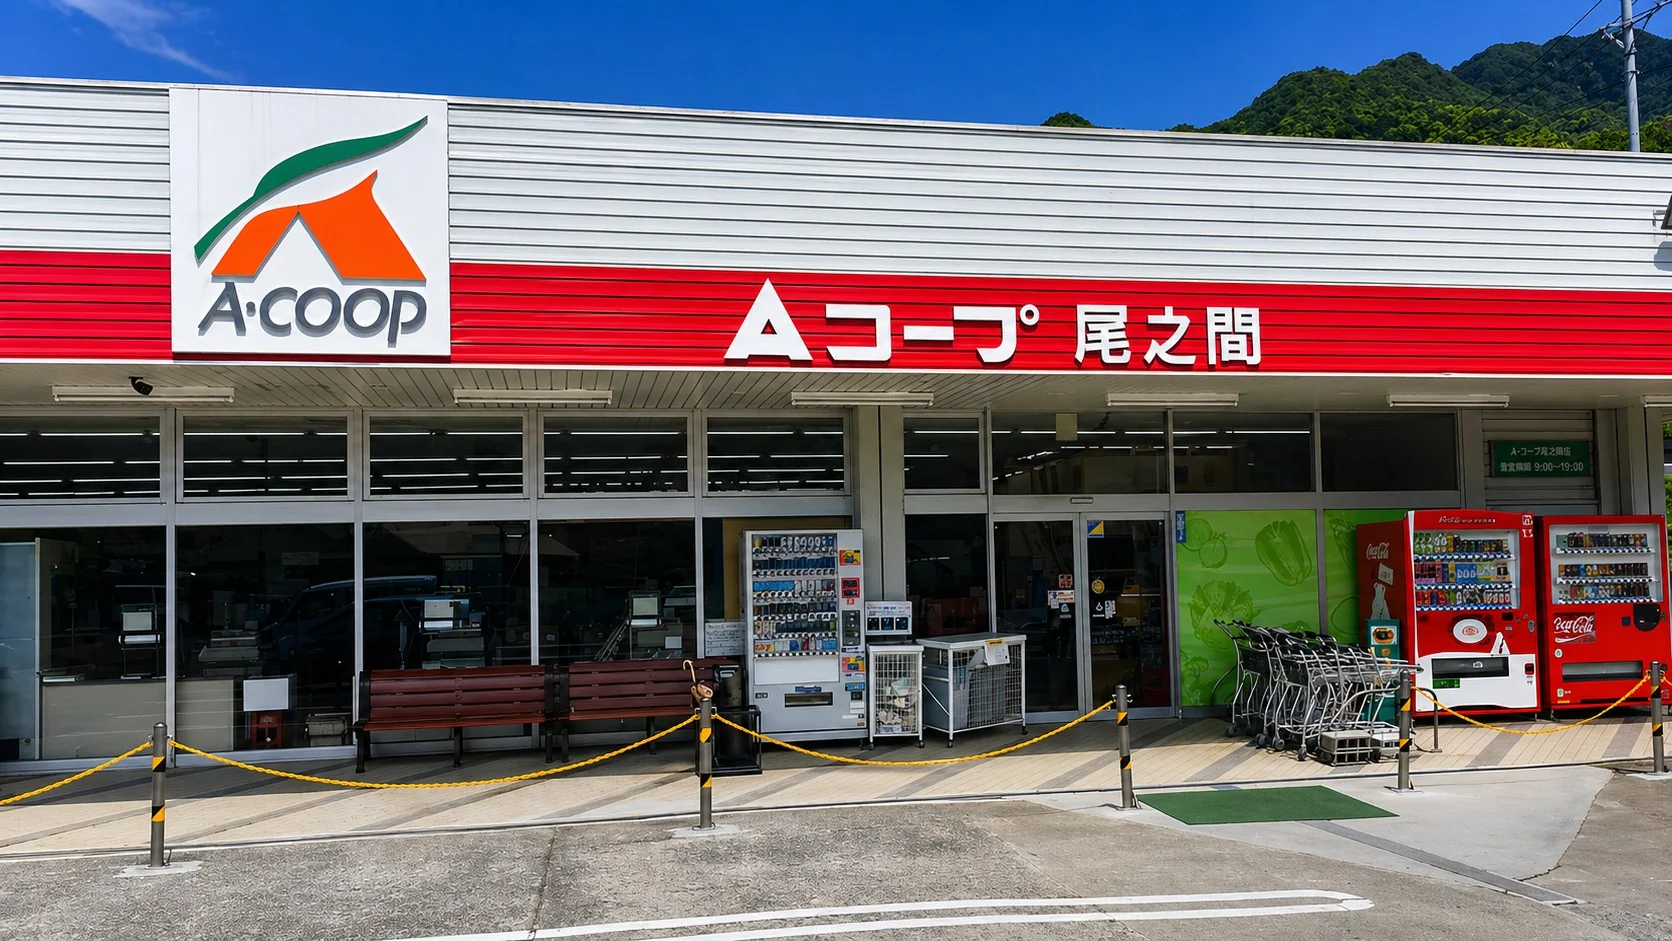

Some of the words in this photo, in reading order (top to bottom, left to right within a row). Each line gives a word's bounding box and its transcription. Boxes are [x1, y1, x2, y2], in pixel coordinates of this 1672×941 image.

[724, 277, 1041, 363] Aコープ
[1074, 304, 1262, 366] 尾之間
